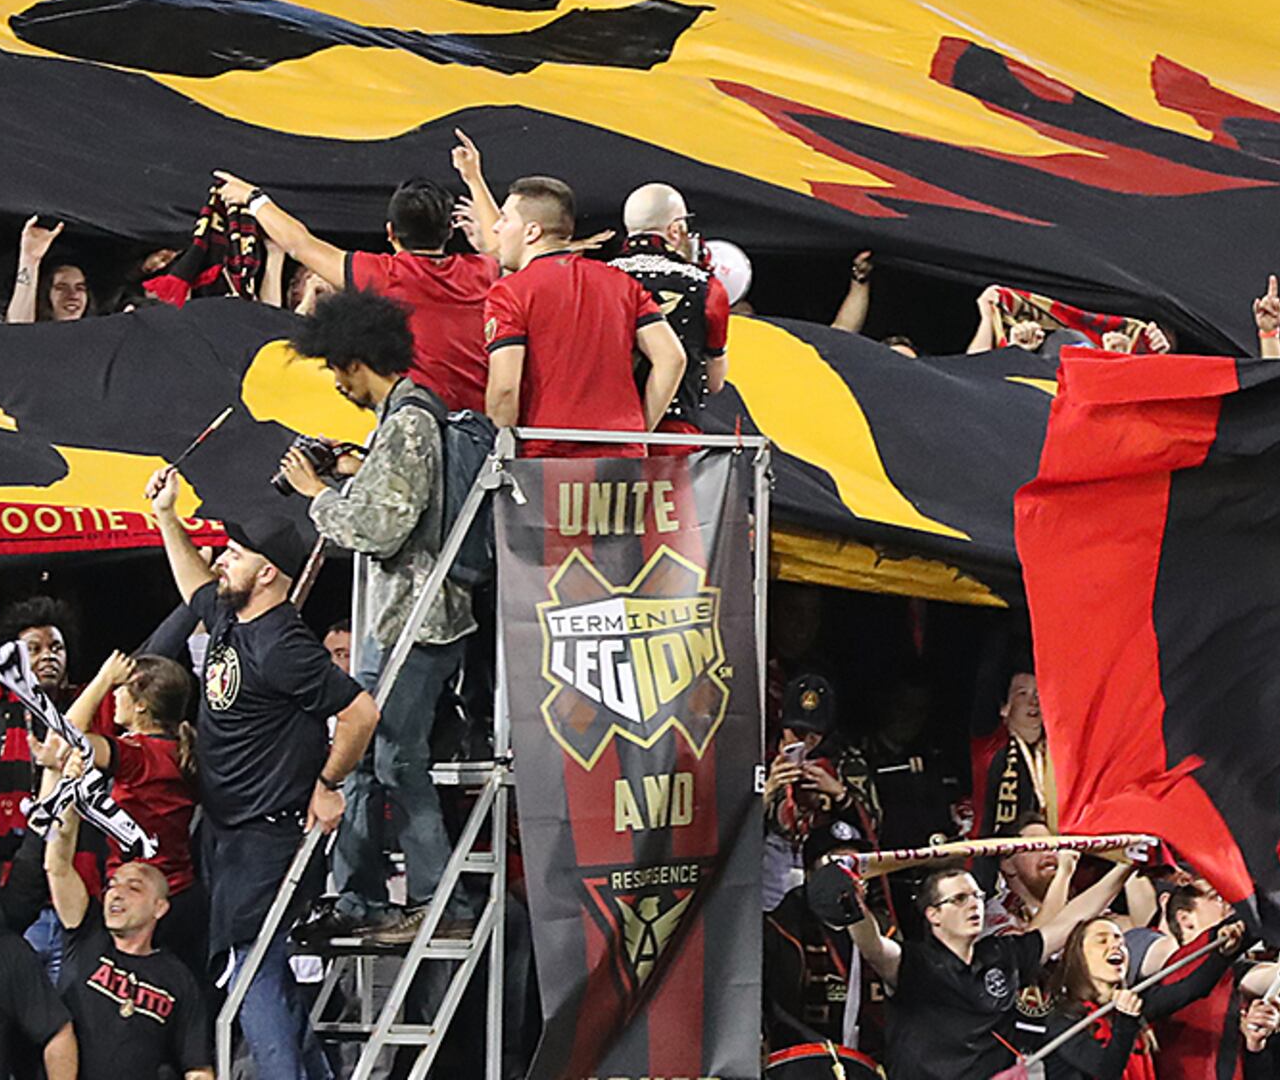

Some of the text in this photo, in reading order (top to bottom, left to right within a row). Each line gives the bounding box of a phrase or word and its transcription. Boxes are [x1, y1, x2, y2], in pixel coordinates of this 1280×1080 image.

[558, 480, 680, 536] UNITE
[551, 601, 714, 634] TERMINUS
[550, 626, 716, 724] LEGION
[613, 772, 695, 833] AND
